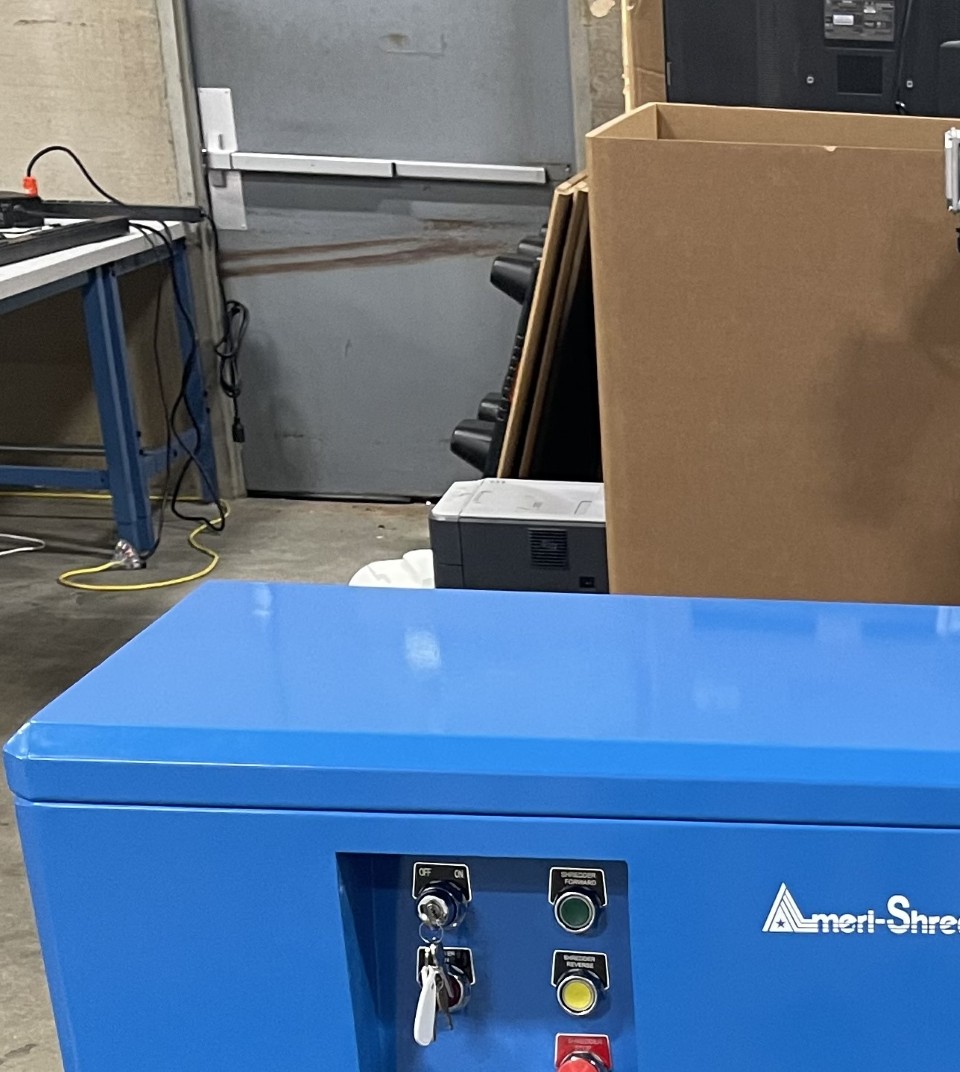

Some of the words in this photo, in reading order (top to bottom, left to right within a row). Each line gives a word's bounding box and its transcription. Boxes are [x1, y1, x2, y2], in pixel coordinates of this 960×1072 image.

[419, 867, 432, 876] OFF
[454, 869, 465, 879] ON
[566, 961, 594, 969] REVERSE
